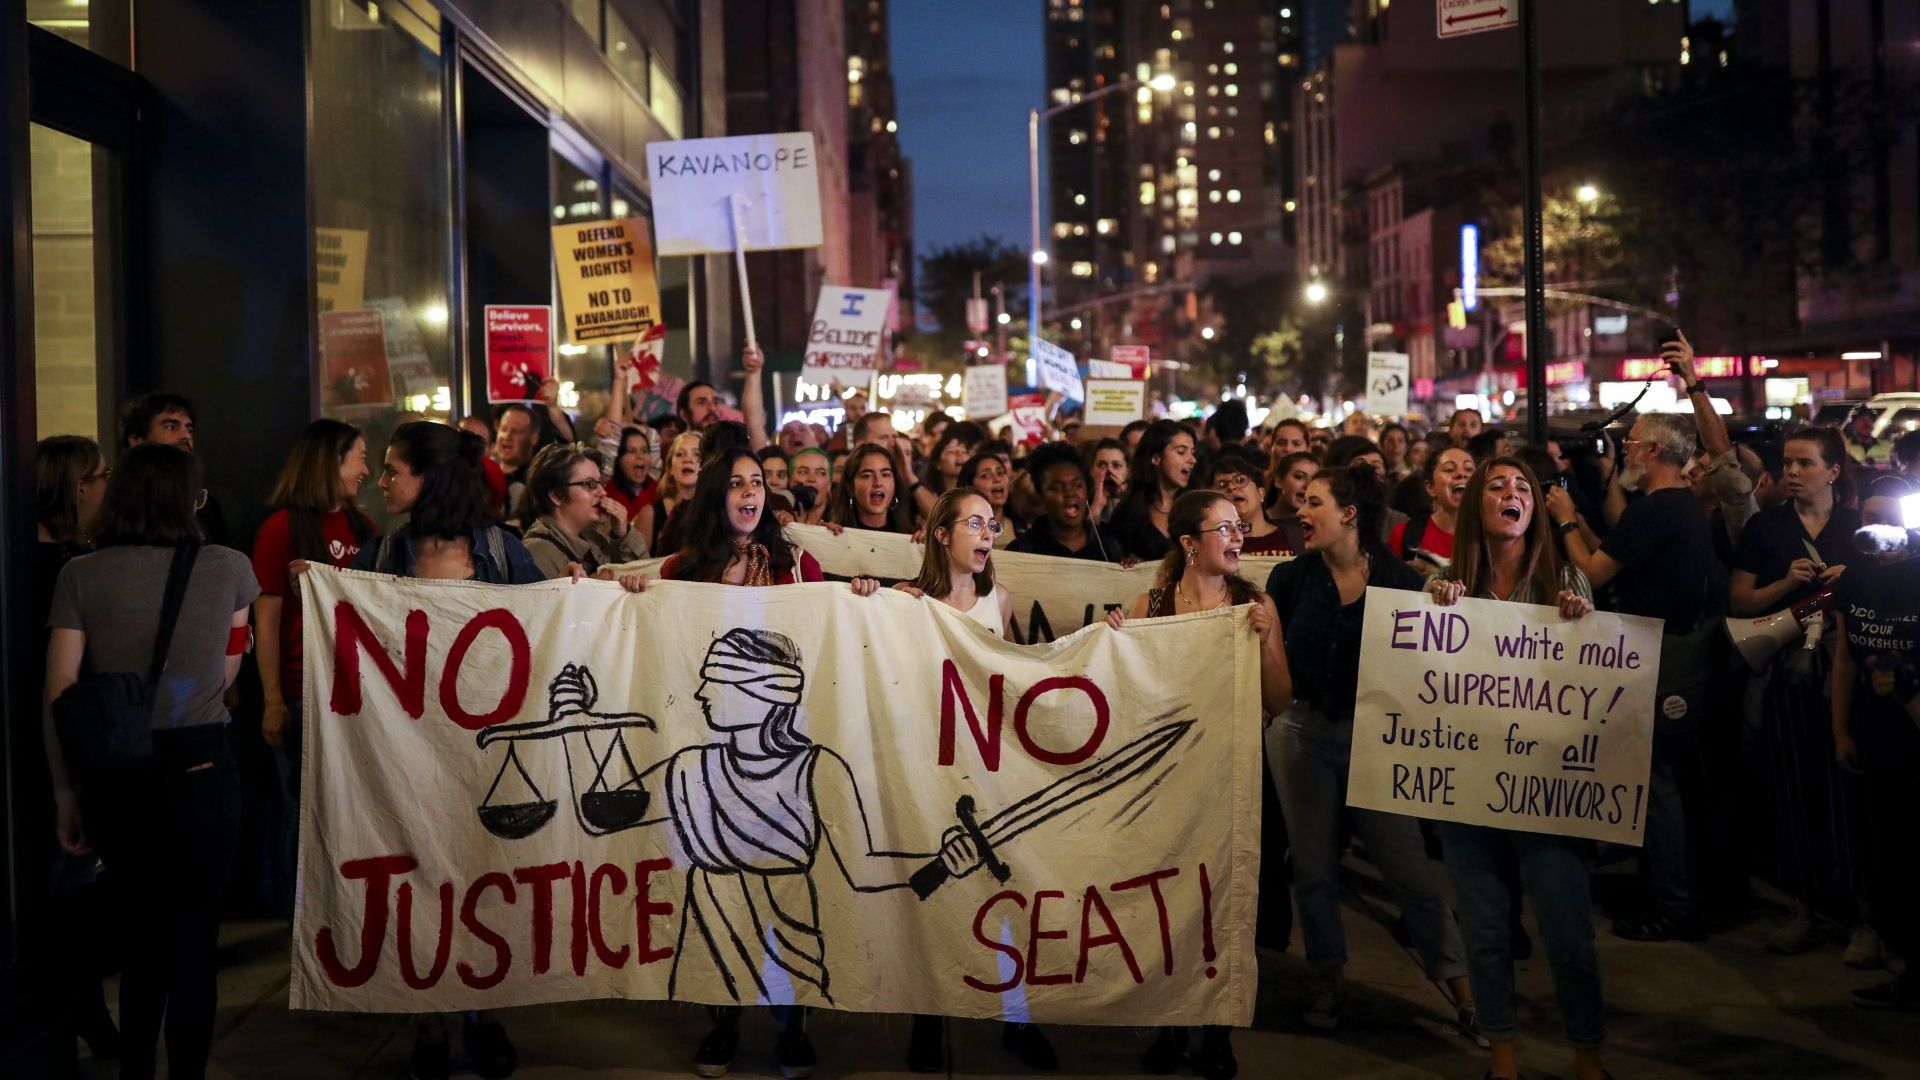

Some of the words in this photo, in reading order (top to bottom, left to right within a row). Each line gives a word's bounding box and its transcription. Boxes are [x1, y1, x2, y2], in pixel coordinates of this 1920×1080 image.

[658, 147, 809, 178] KAVANOPE
[577, 225, 624, 243] DEFEND
[572, 241, 634, 261] WOMEN'S
[580, 260, 632, 278] RIGHTS!
[588, 290, 610, 308] NO
[613, 288, 632, 304] TO
[840, 293, 865, 315] I
[490, 310, 529, 320] Believe
[575, 305, 650, 326] KAVANAUGH!
[1391, 609, 1470, 654] END
[1494, 624, 1564, 661] white
[1578, 634, 1641, 670] male
[1848, 631, 1915, 650] OOKSHELF
[1861, 621, 1894, 636] YOUR
[330, 601, 531, 730] NO
[1417, 669, 1625, 725] SUPREMACY!
[938, 658, 1110, 772] NO
[1381, 712, 1479, 751] Justice
[1504, 722, 1539, 756] for
[1562, 734, 1599, 766] all
[1392, 763, 1456, 806] RAPE
[1486, 771, 1644, 831] SURVIVORS!
[315, 855, 674, 990] JUSTICE
[964, 862, 1218, 993] SEAT!
